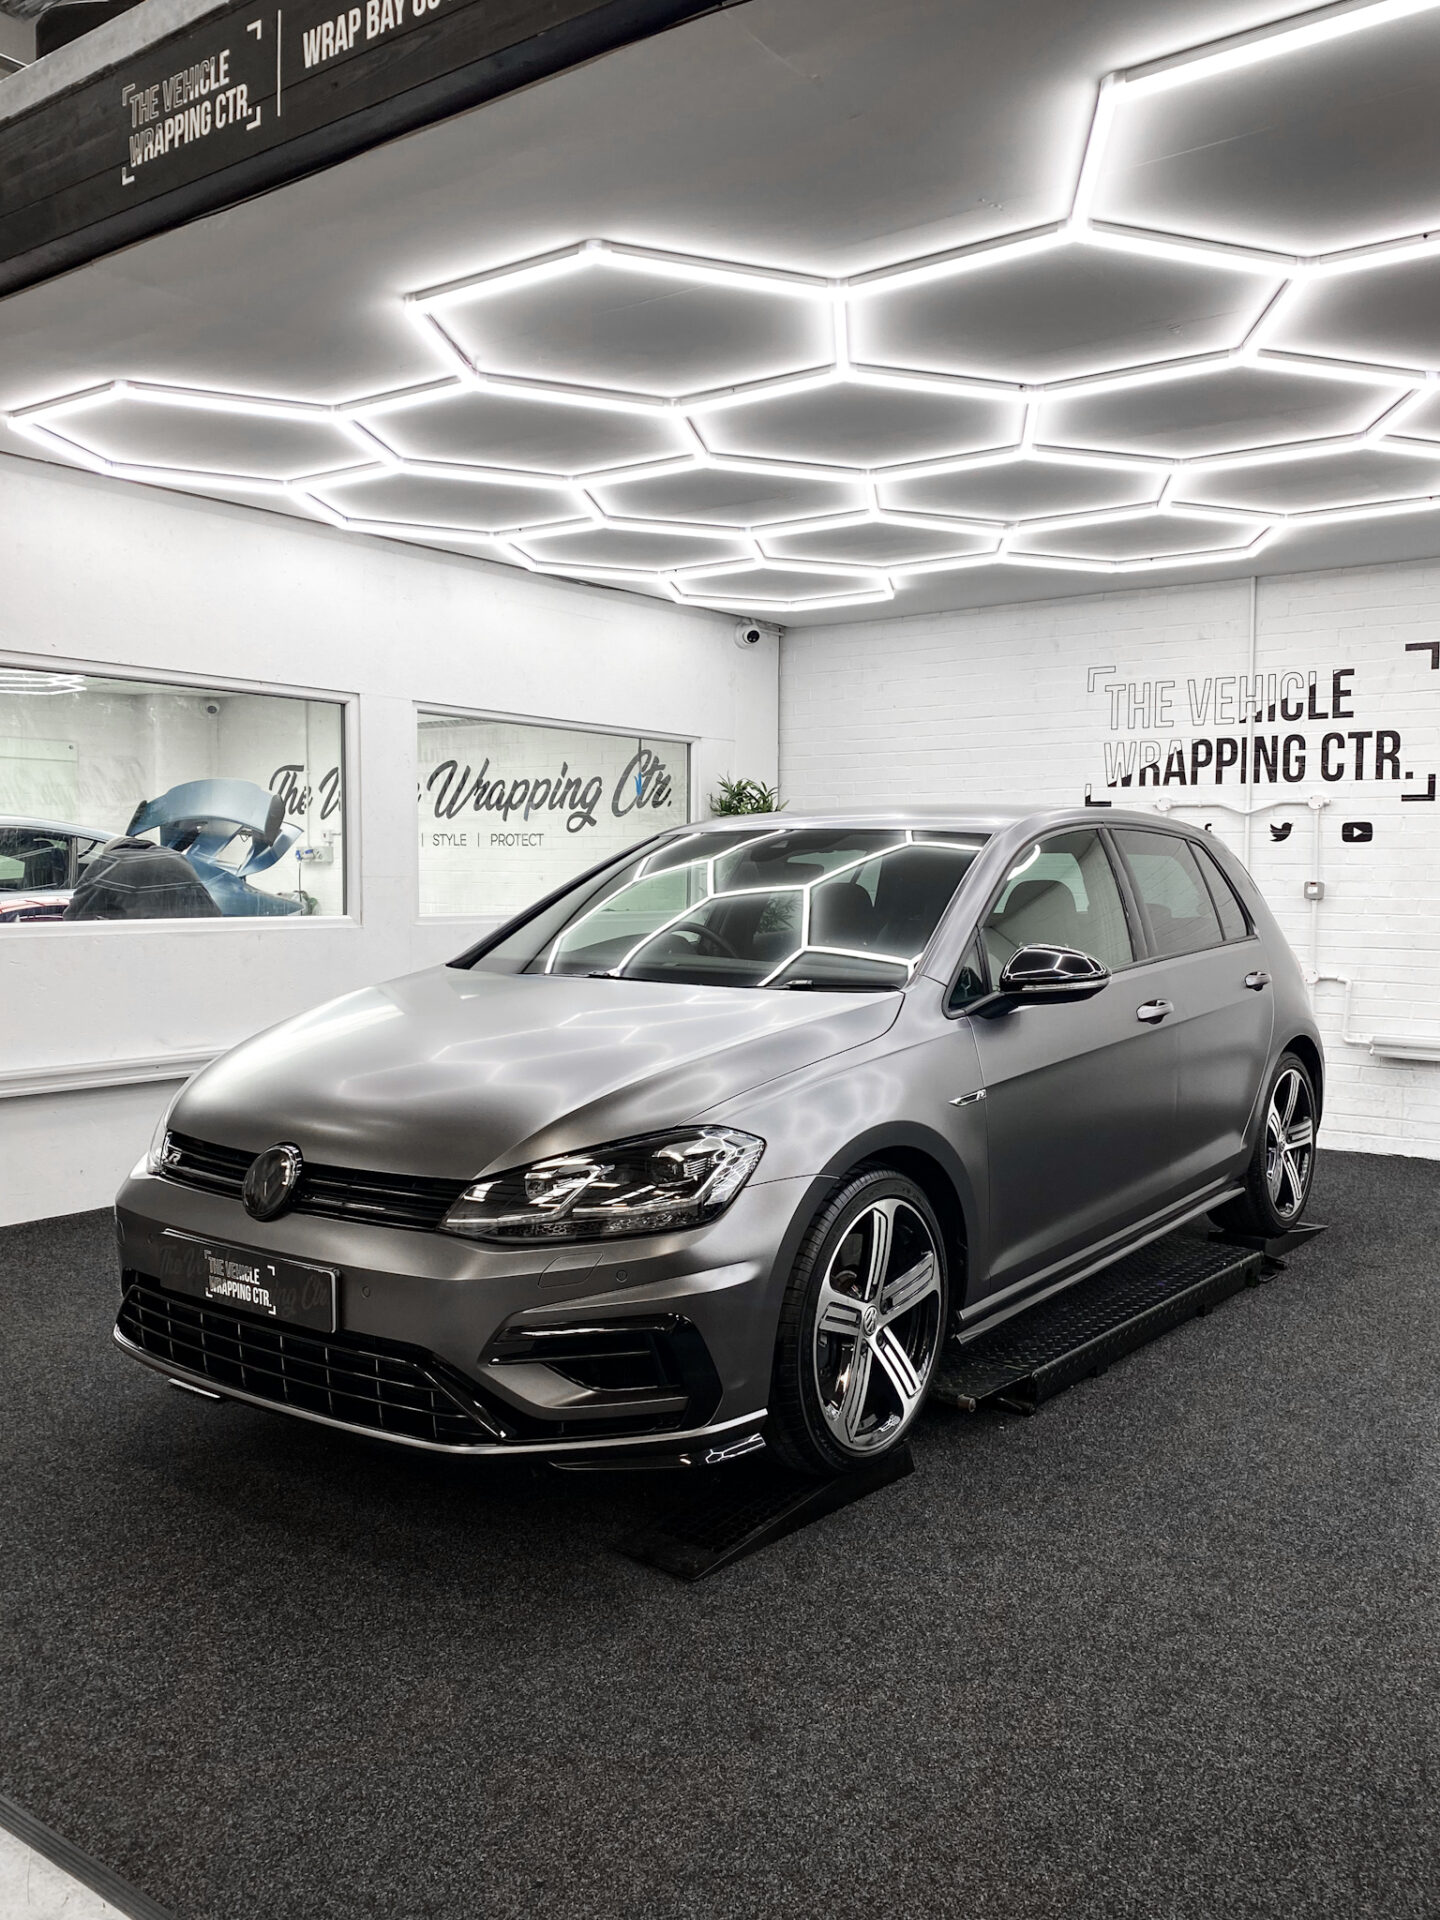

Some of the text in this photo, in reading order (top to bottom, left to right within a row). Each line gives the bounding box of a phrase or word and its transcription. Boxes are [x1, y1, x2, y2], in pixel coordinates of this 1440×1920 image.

[303, 0, 404, 69] WRAP BAY
[129, 49, 230, 128] THE VEHICLE
[128, 83, 253, 168] WRAPPING CTR.
[1104, 668, 1355, 731] THE VEHICLE
[1103, 730, 1414, 788] WRAPPING CTR.
[269, 765, 313, 816] The
[427, 758, 603, 834] Wrapping
[611, 749, 672, 818] Ctr.
[432, 833, 545, 847] STYLE PROTECT
[208, 1256, 225, 1276] THE
[225, 1261, 260, 1285] VEHICLE
[208, 1275, 251, 1302] WRAPPING
[252, 1287, 273, 1307] CTR.
